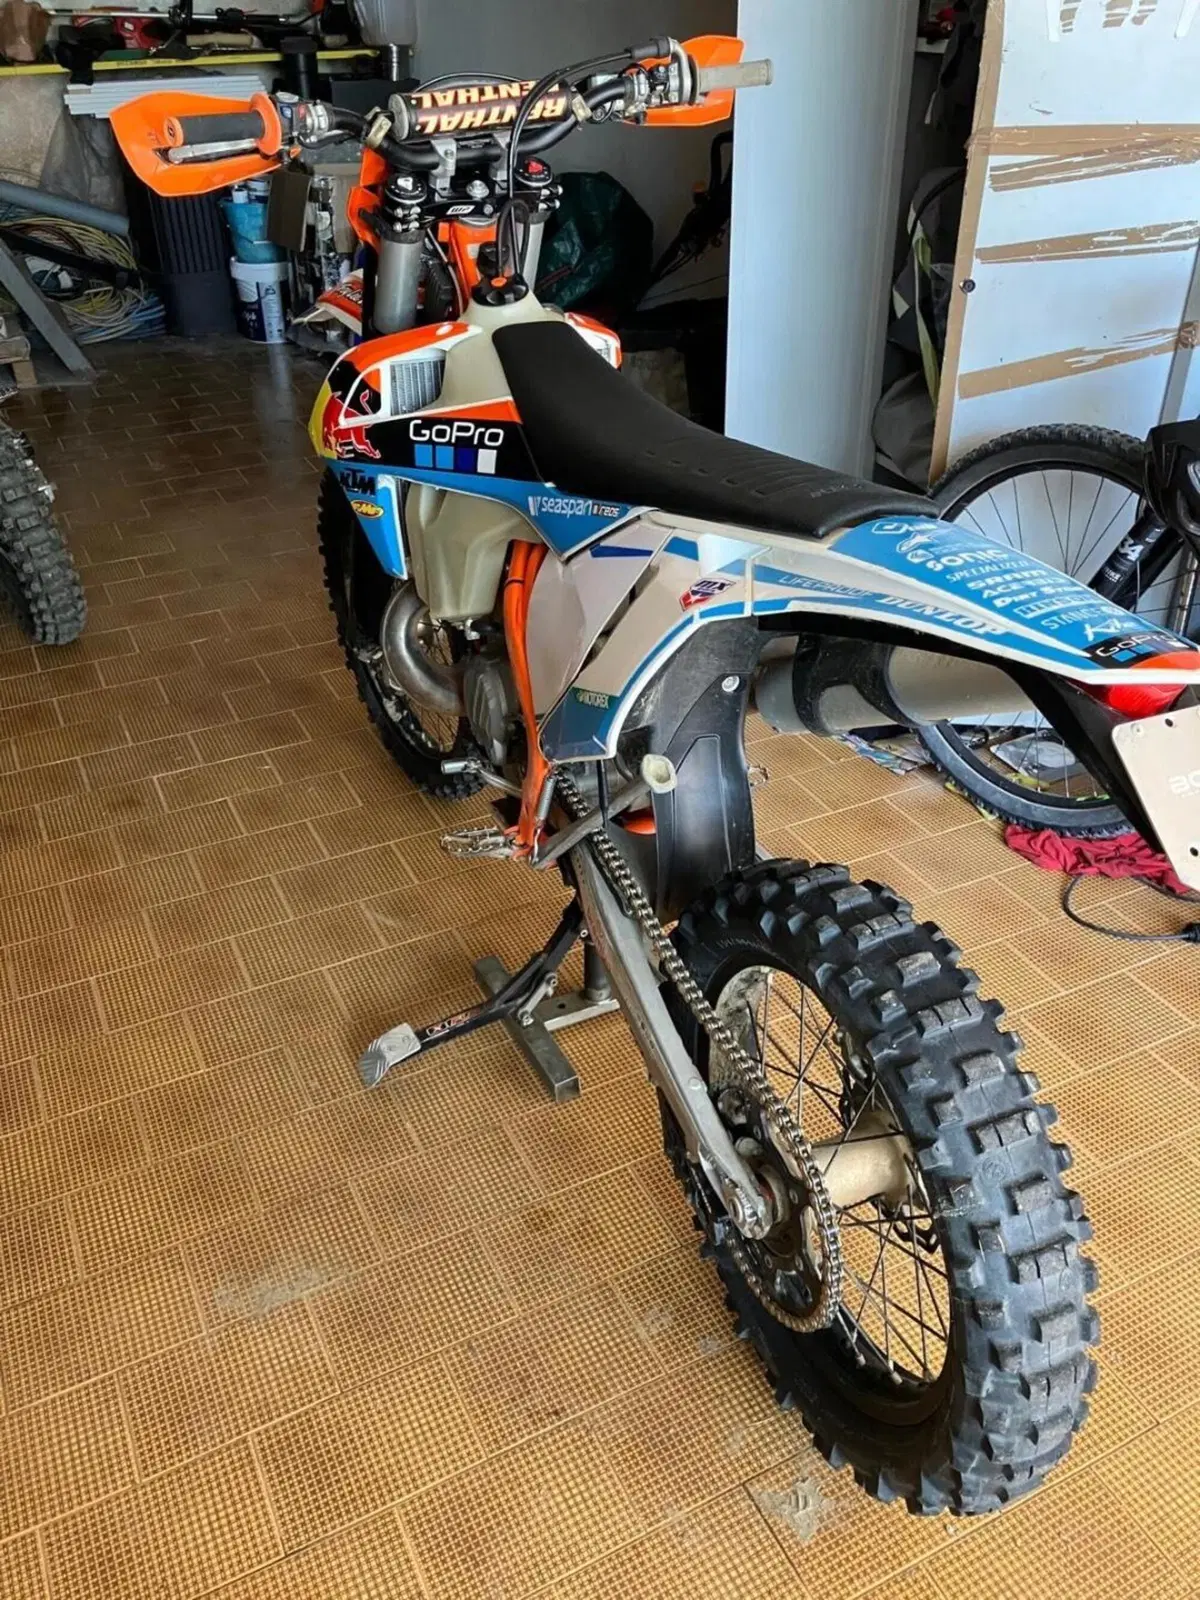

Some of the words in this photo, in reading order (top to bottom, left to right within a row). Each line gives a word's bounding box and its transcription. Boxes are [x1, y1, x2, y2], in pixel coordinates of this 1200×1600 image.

[412, 80, 559, 109] ENTHAL
[409, 419, 504, 446] GoPro
[341, 468, 376, 496] KTM
[541, 496, 593, 519] seaspan
[1118, 534, 1144, 562] 34
[778, 575, 874, 598] LIFEPROOF
[875, 595, 1008, 635] DUNLOP
[1095, 633, 1178, 657] GoPro
